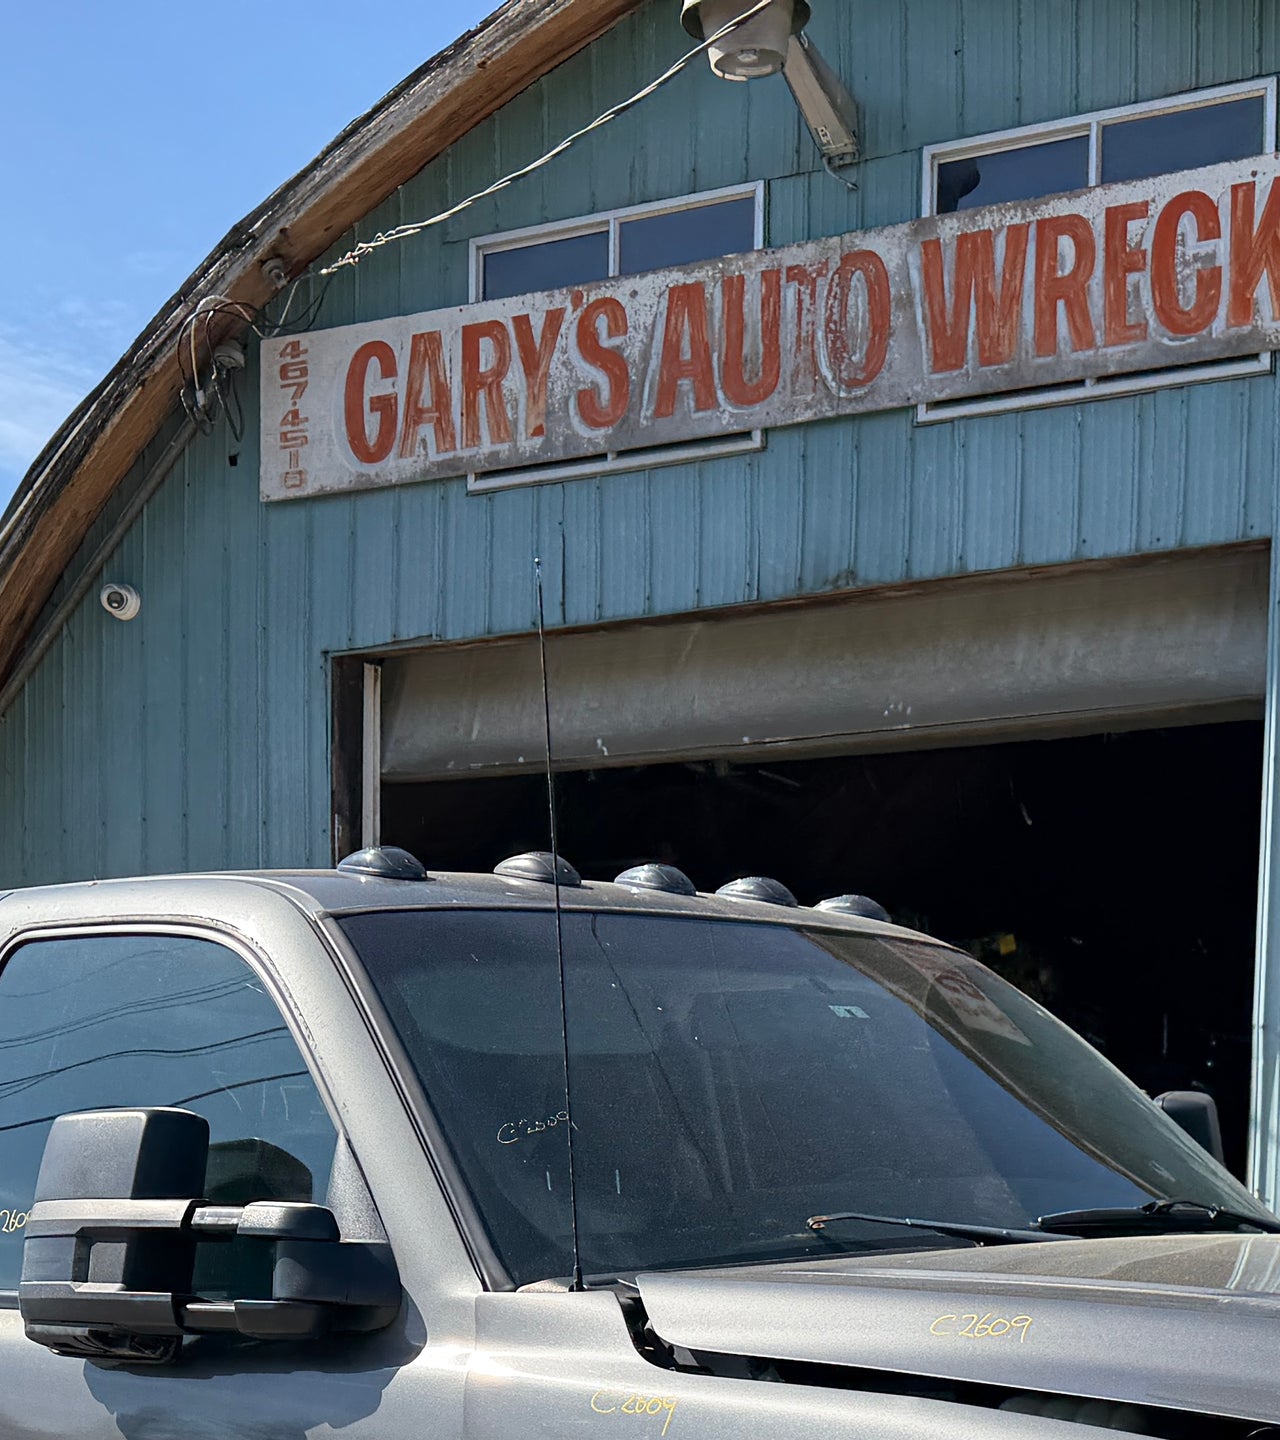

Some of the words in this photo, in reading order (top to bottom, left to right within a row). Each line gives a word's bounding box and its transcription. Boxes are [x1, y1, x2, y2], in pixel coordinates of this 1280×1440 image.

[344, 290, 629, 464] GARY'S
[653, 249, 890, 419] AUTO
[930, 1313, 1034, 1343] C2609
